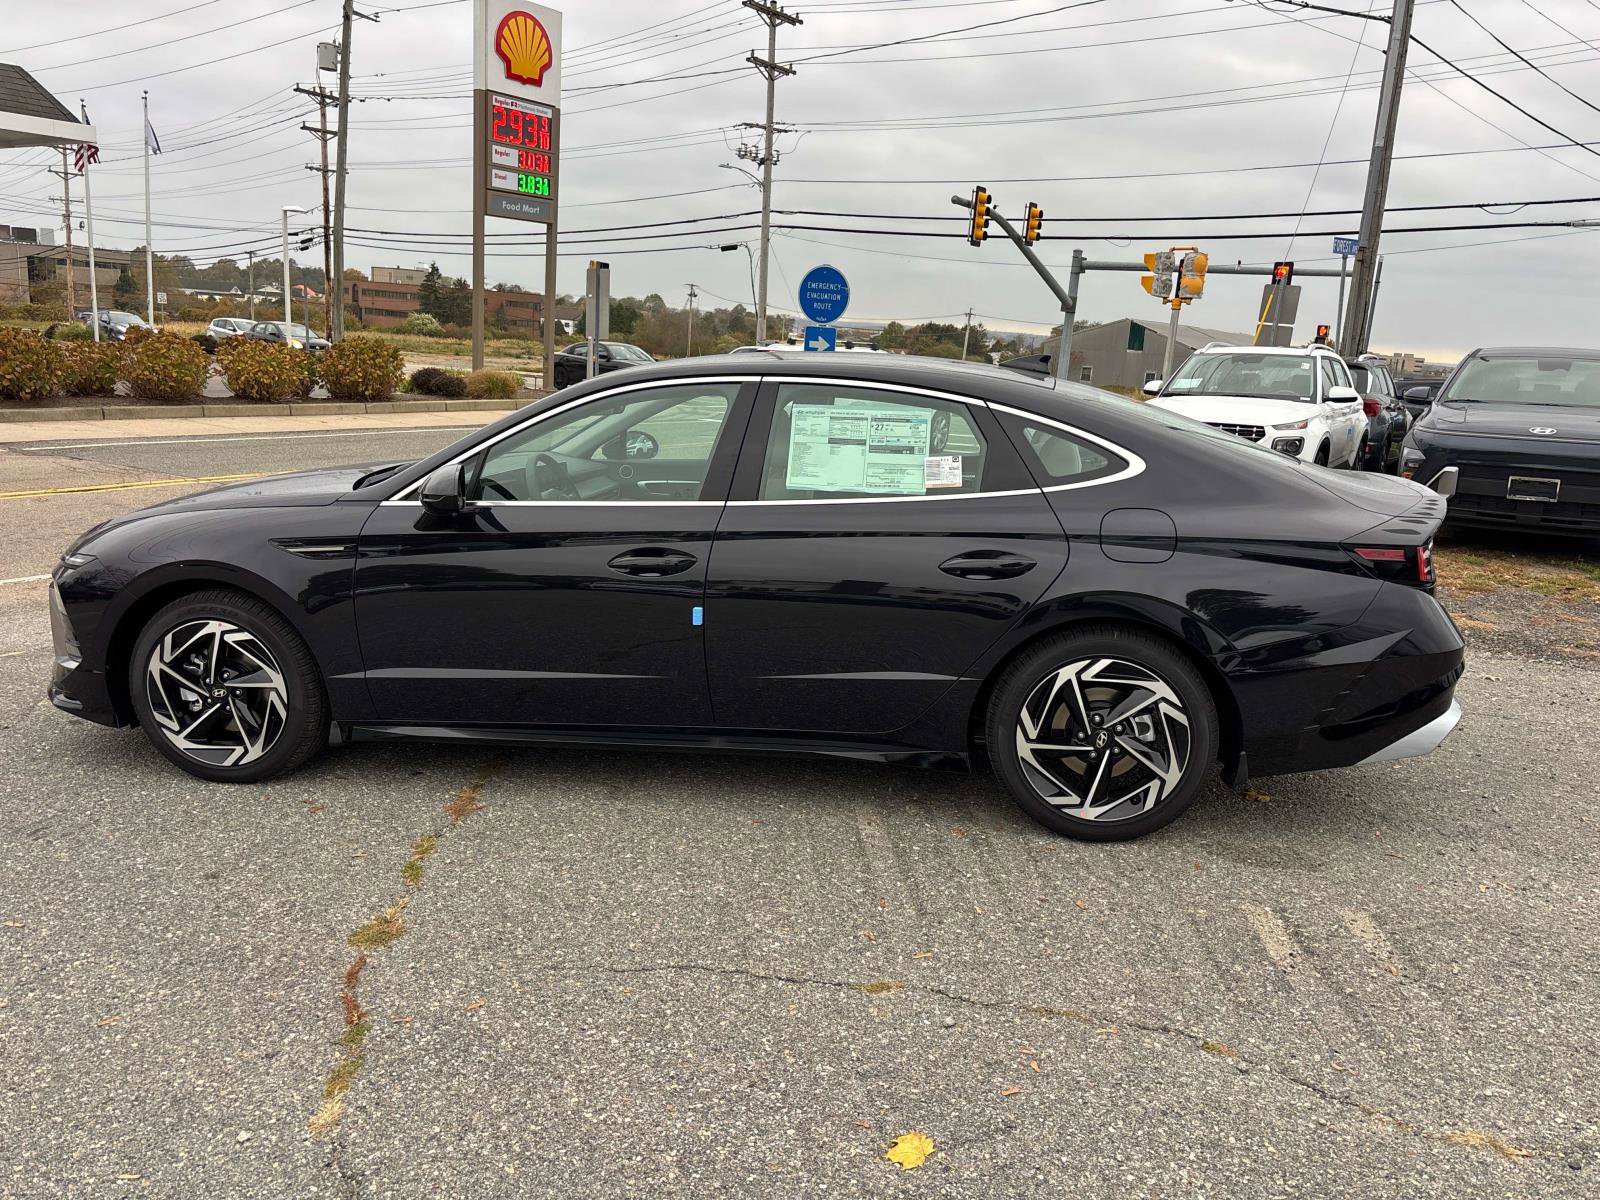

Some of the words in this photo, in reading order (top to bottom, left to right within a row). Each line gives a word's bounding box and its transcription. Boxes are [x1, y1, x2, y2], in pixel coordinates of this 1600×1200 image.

[495, 97, 510, 106] Regular
[494, 105, 538, 147] 2.93
[495, 149, 510, 157] Regular
[502, 201, 520, 211] Food
[522, 205, 540, 214] Mart
[1333, 239, 1352, 253] FOREST
[807, 281, 842, 291] EMERGENCY
[806, 291, 841, 301] EVACUATION
[813, 302, 832, 311] ROUTE
[874, 423, 884, 431] 27
